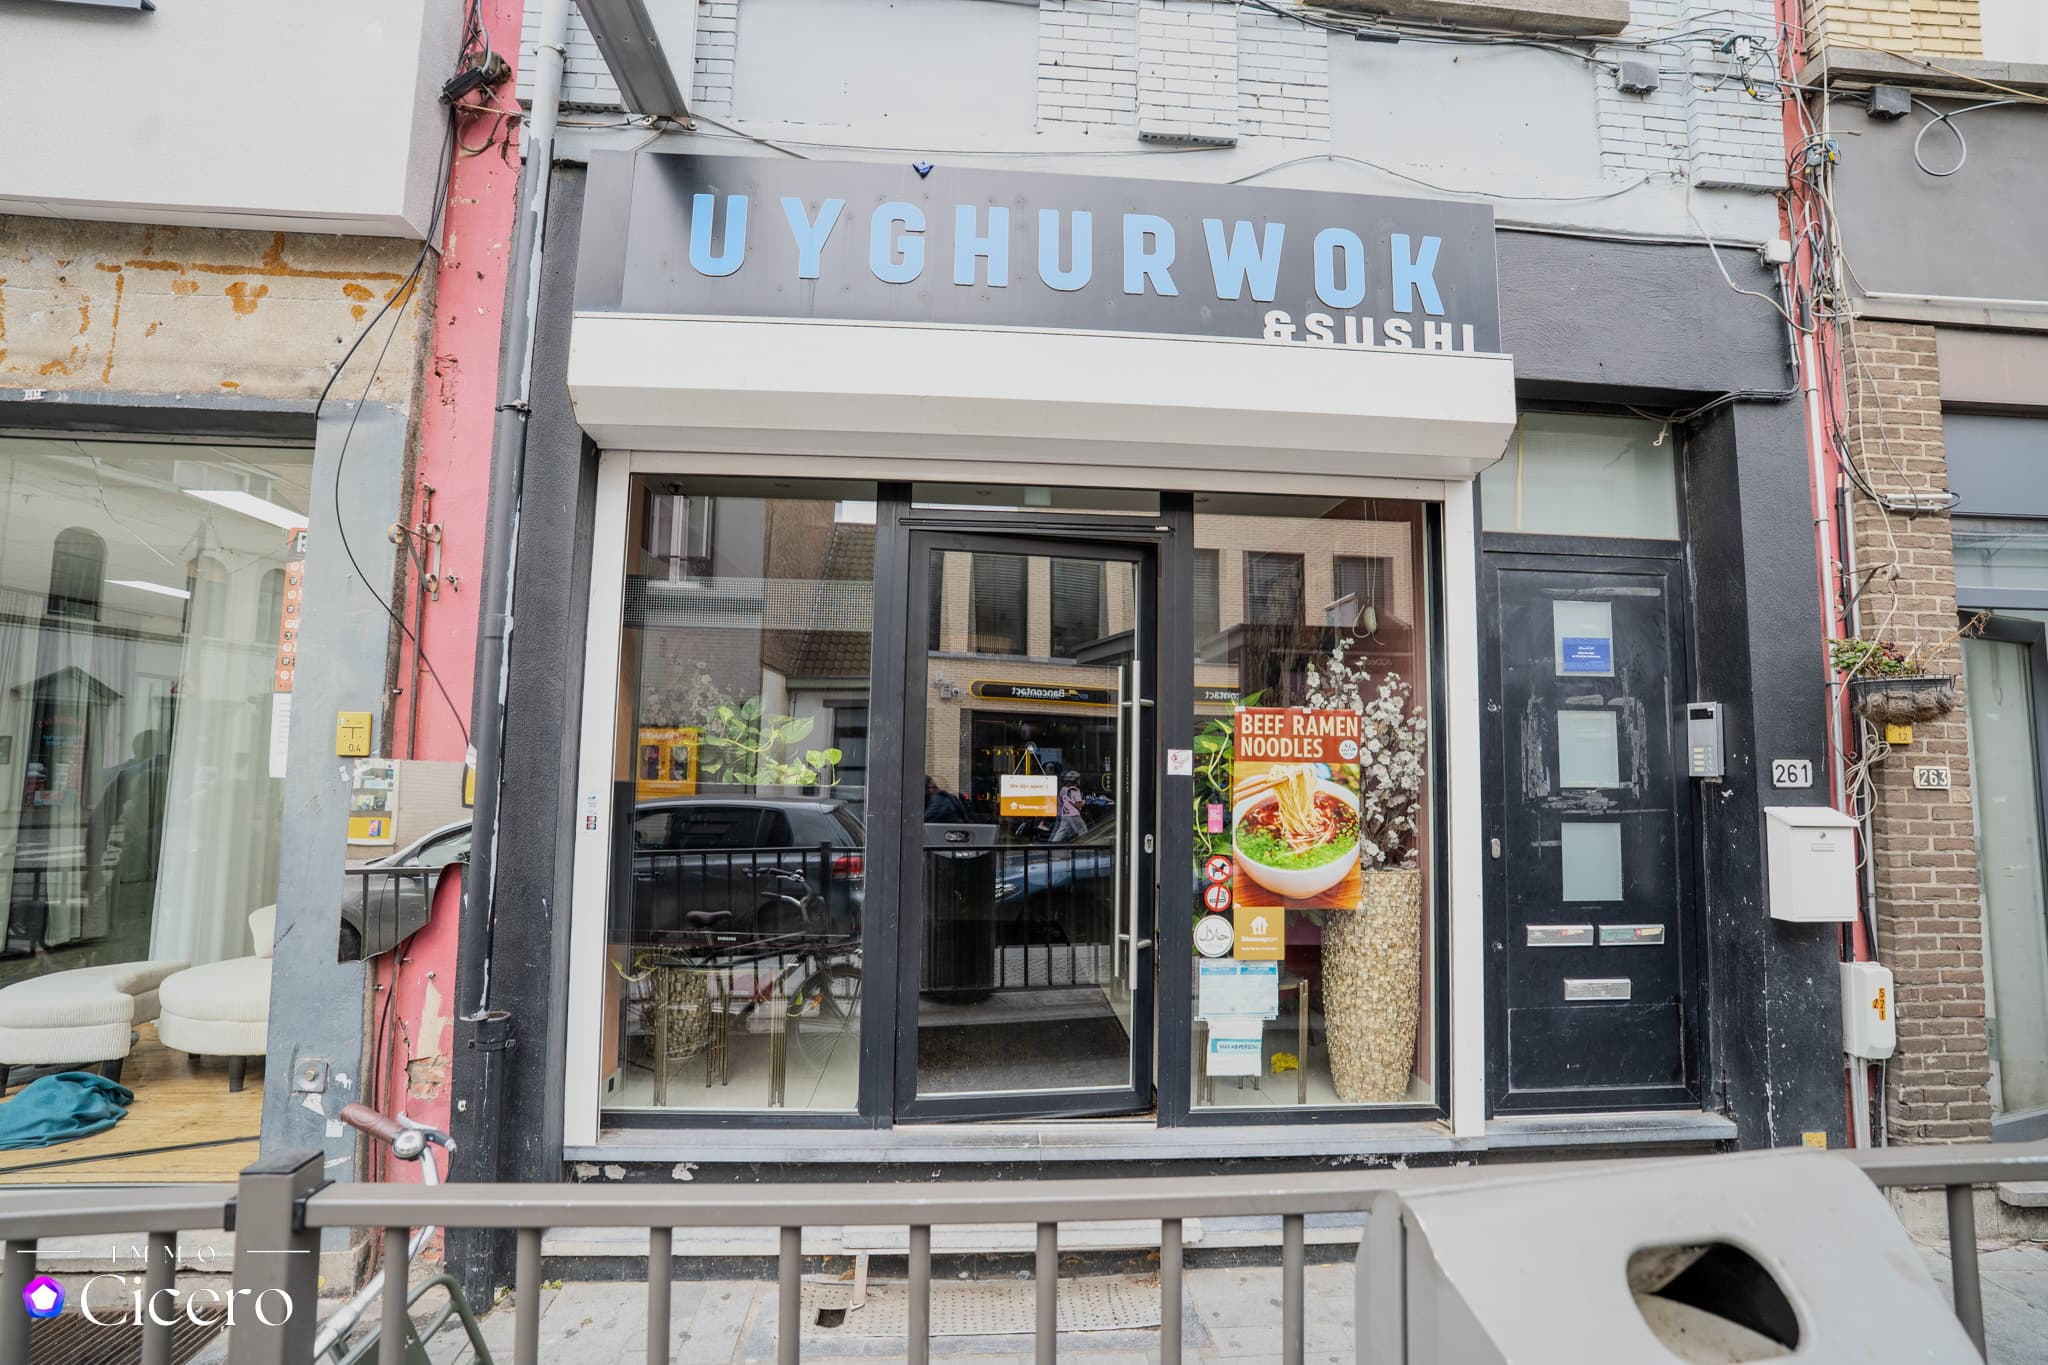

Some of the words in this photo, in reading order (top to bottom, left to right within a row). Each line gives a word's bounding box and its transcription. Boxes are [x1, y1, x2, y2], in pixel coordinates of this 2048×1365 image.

[1240, 713, 1286, 736] BEEF
[1292, 714, 1359, 737] RAMEN
[1240, 736, 1324, 759] NOODLES
[1775, 763, 1809, 784] 261
[1919, 768, 1948, 786] 263
